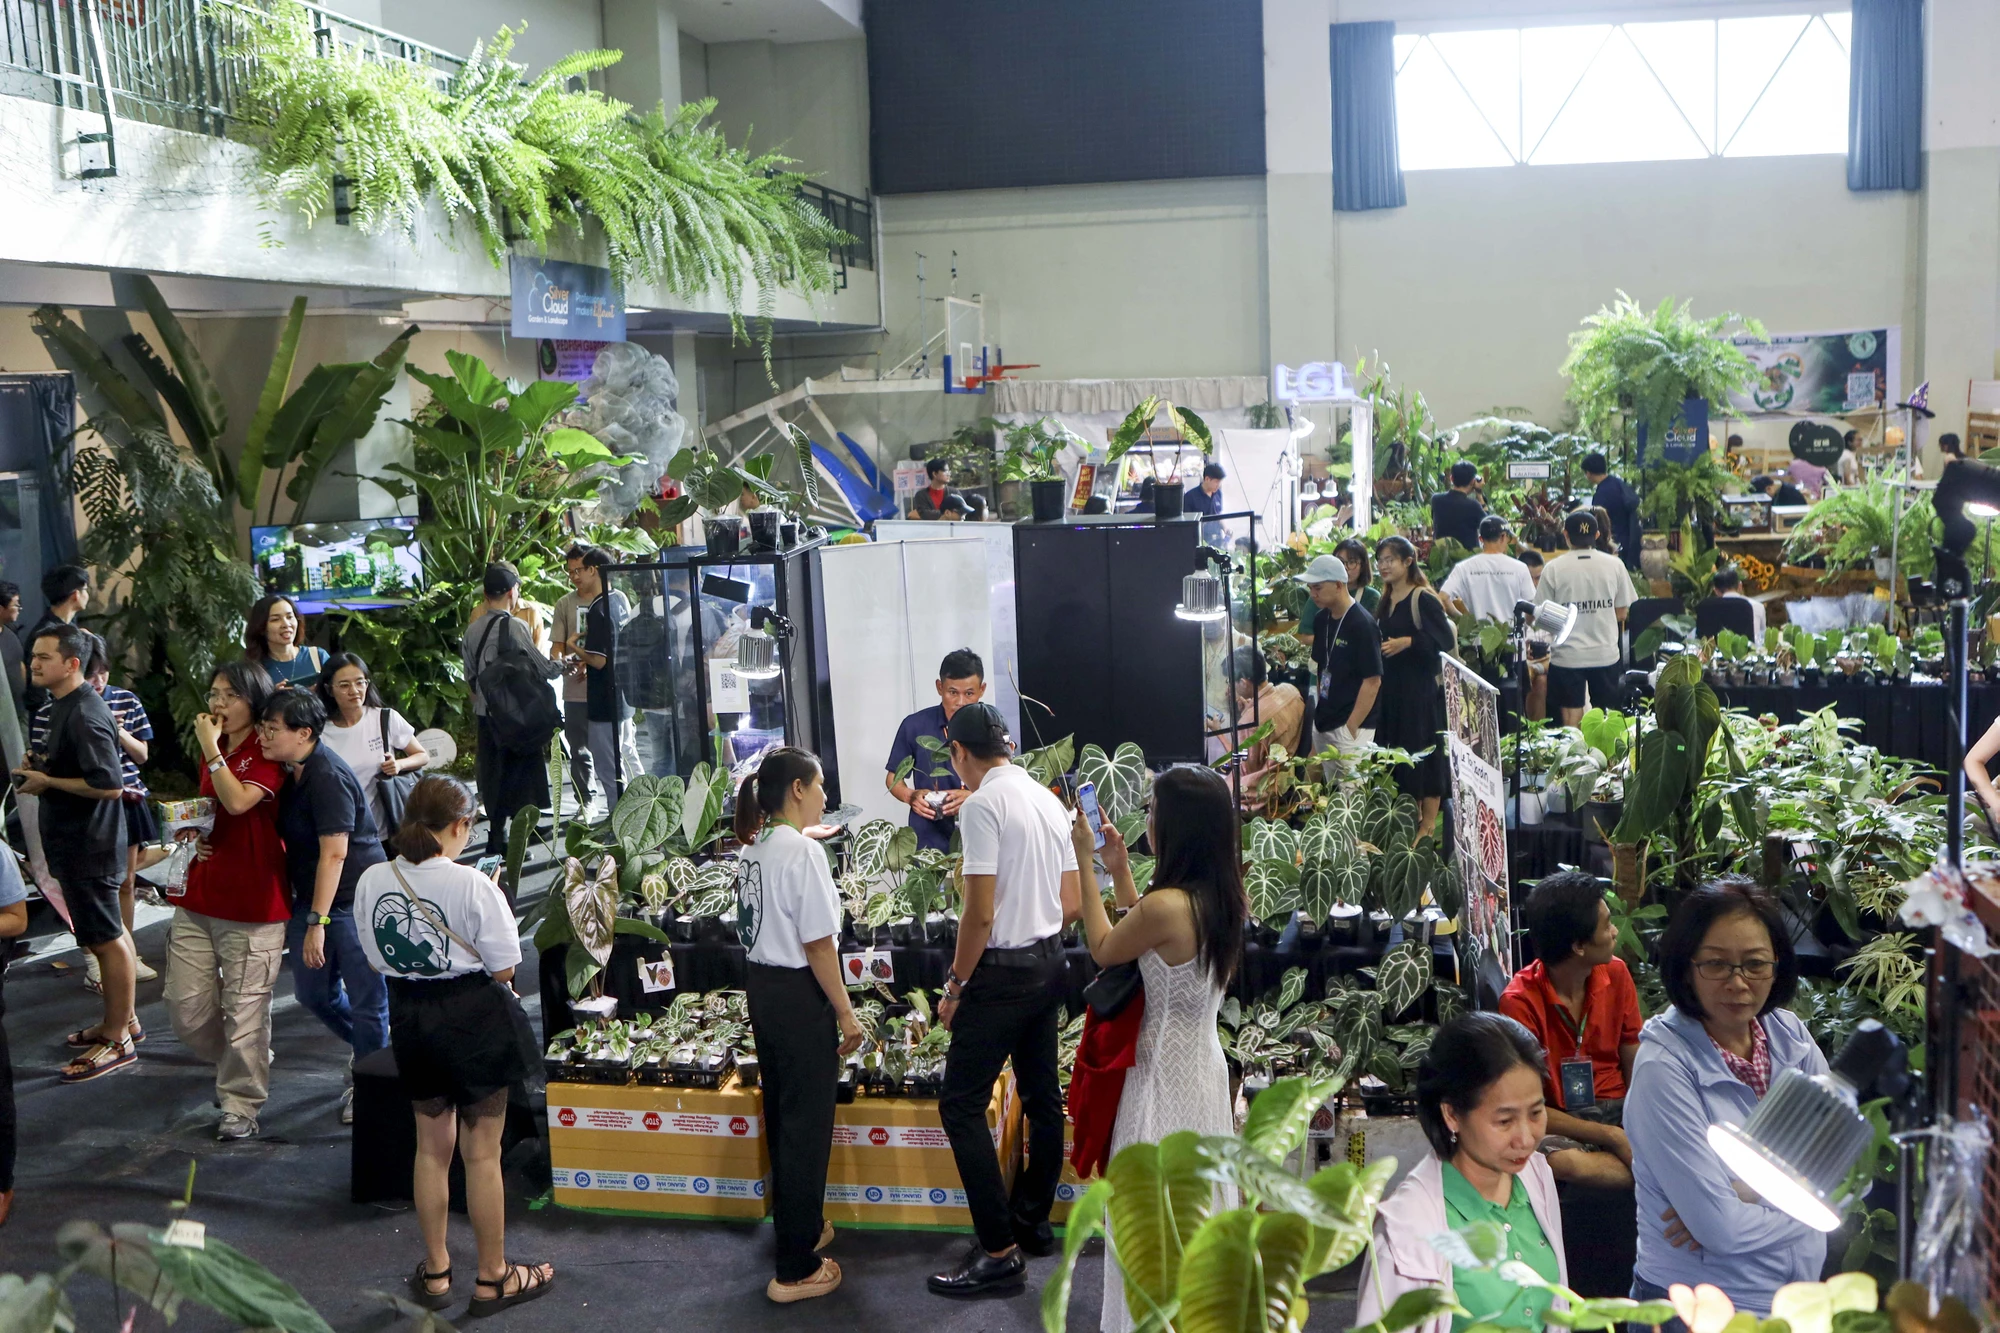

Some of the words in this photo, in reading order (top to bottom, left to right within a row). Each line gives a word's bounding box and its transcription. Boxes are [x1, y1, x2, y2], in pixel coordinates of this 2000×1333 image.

[549, 285, 570, 300] Silver
[542, 292, 568, 314] Cloud
[528, 315, 544, 323] Garden
[548, 317, 568, 326] Landscape
[1276, 362, 1356, 399] LGL
[1665, 430, 1696, 442] Cloud
